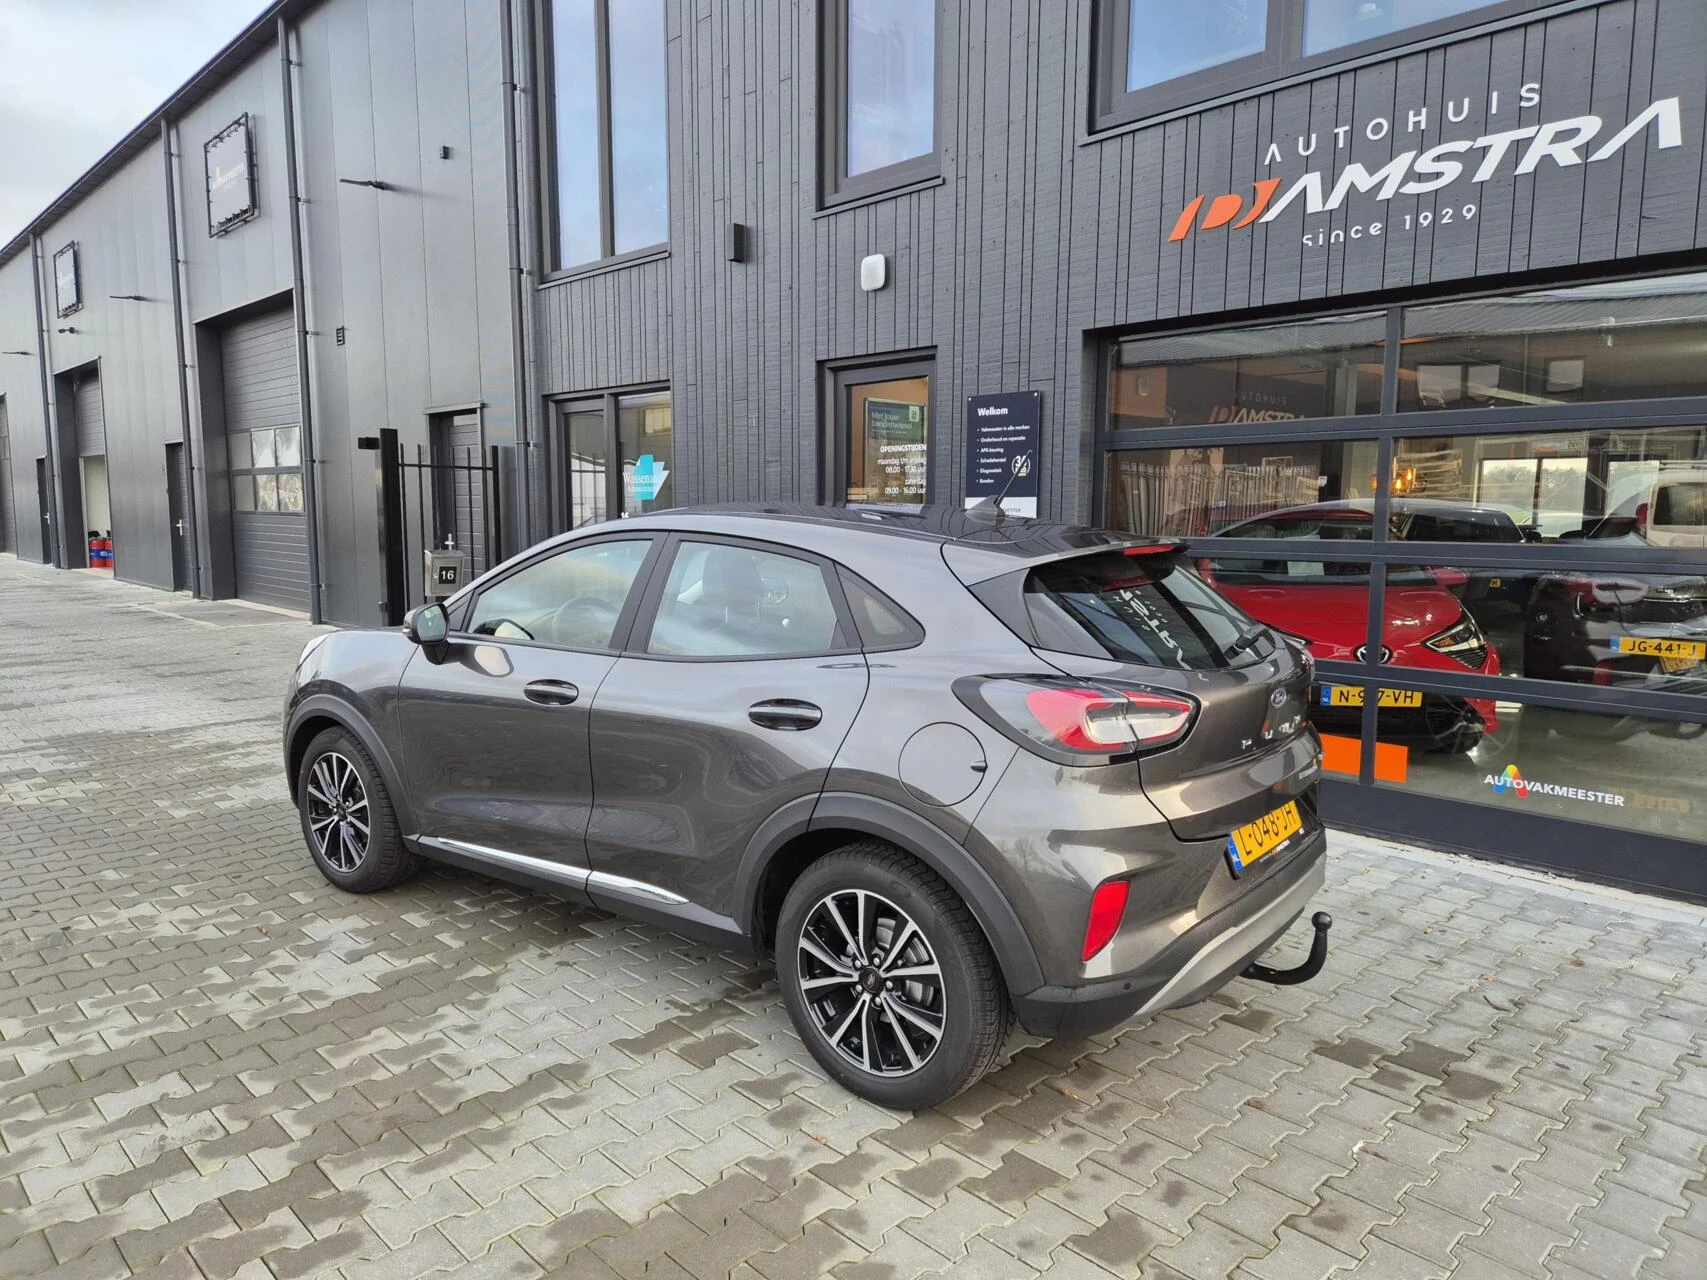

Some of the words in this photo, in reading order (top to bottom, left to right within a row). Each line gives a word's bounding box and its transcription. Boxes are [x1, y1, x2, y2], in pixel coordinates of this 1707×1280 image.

[1264, 83, 1541, 165] AUTOHUIS
[1302, 222, 1383, 247] since
[1404, 204, 1477, 230] 1929
[977, 406, 1009, 416] Welkom
[880, 443, 927, 453] OPENINGSTIJDEN
[877, 456, 900, 466] maandag
[441, 570, 455, 580] 16
[1338, 689, 1414, 705] N-97-VH
[1483, 773, 1625, 807] AUTOVAKMEESTER
[1238, 803, 1297, 857] L-048-JH
